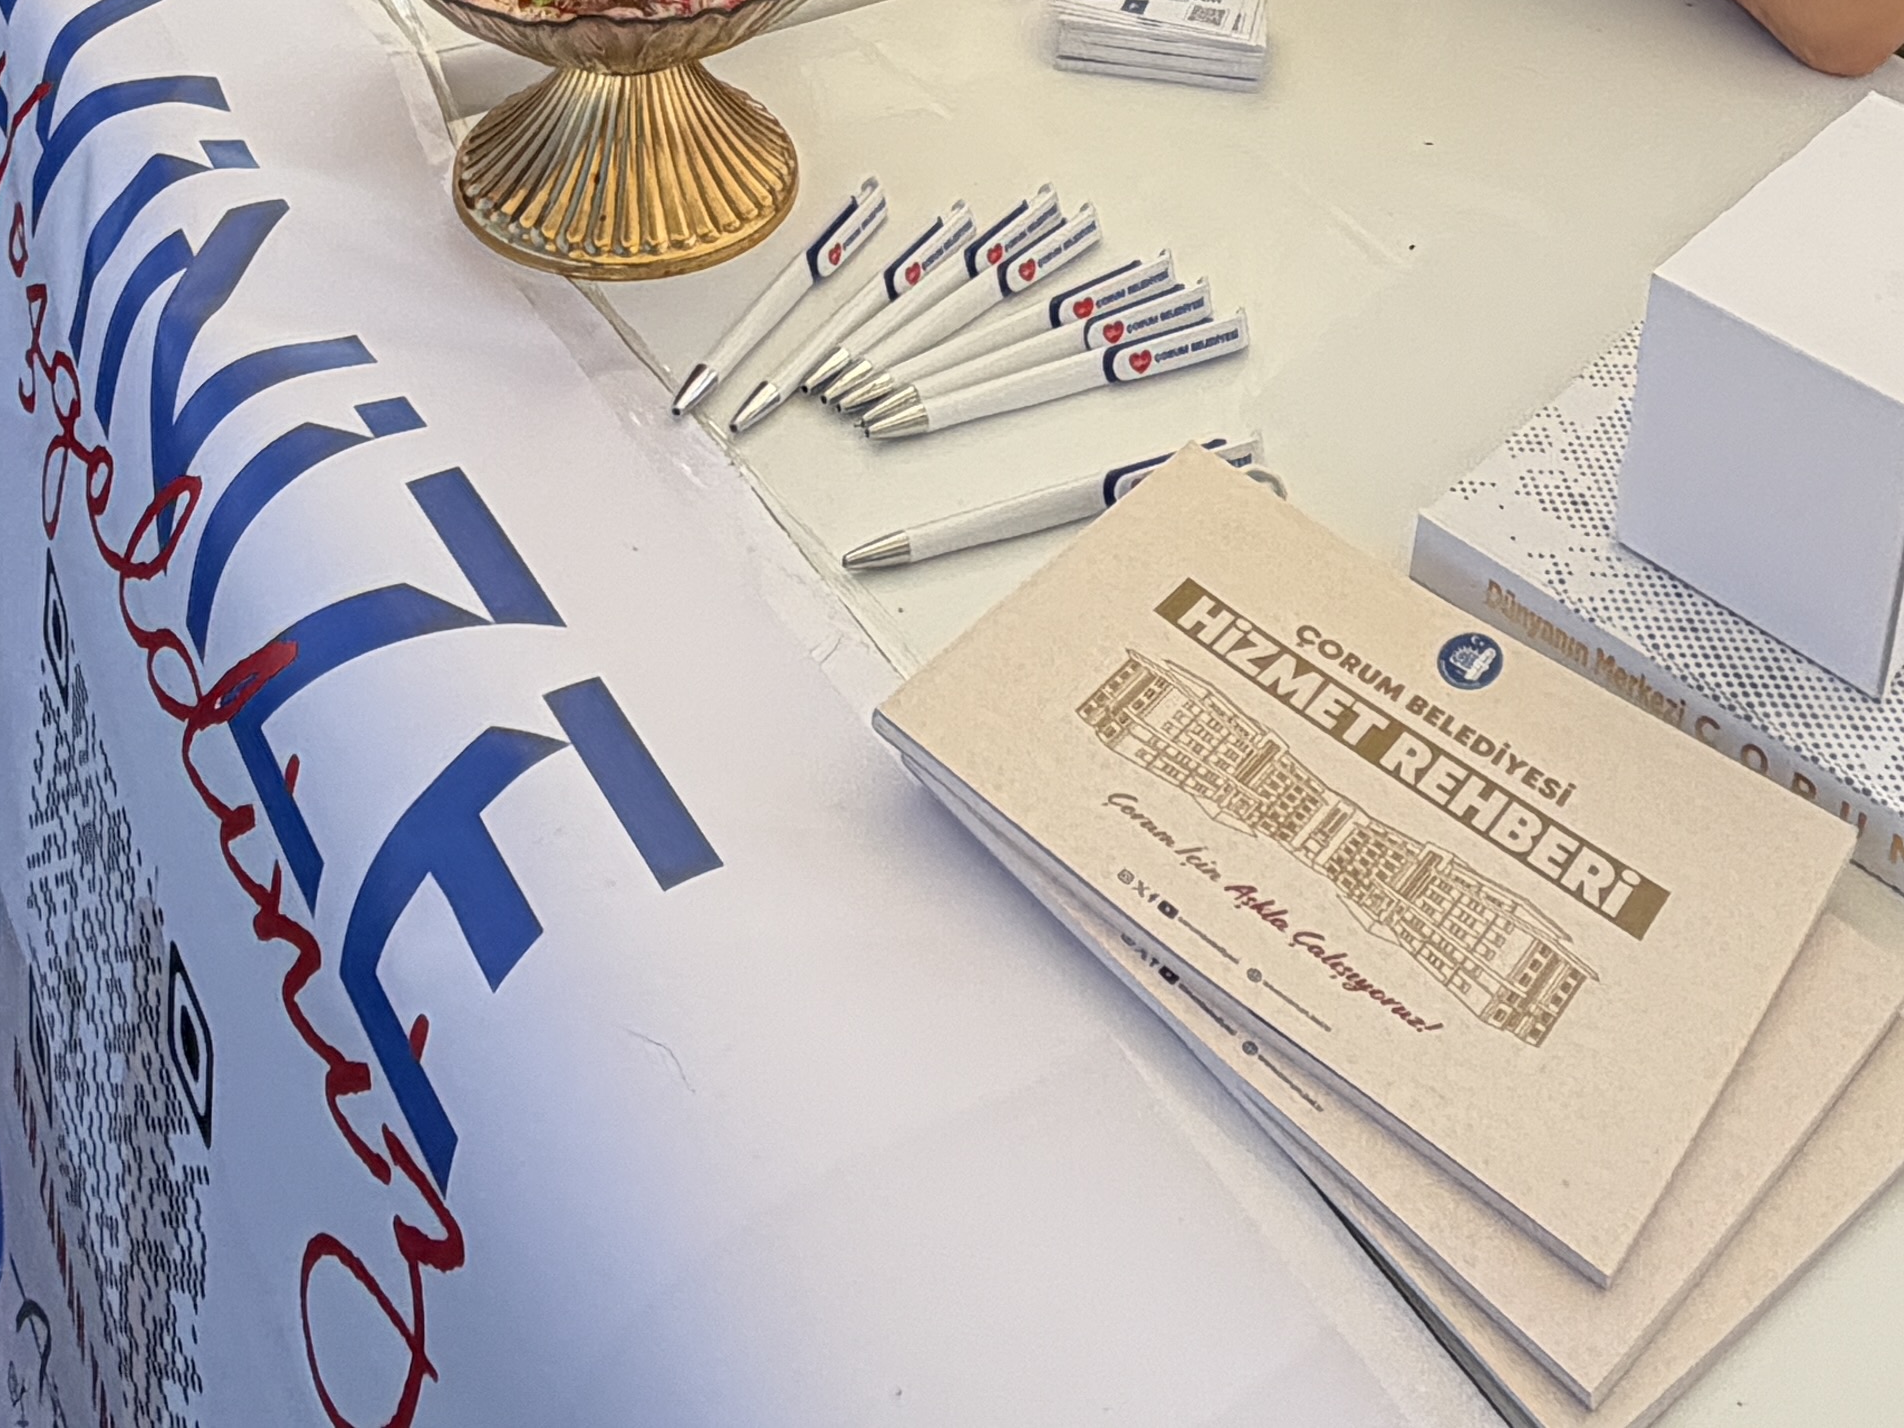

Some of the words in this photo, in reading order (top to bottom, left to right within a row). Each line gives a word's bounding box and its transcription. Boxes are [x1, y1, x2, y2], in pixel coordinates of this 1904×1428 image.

[1176, 594, 1388, 749] HİZMET
[1380, 730, 1641, 916] REHBERİ
[1295, 624, 1407, 703] ÇORUM
[1404, 692, 1577, 809] BELEDİYESİ
[1101, 792, 1175, 848] Çorum
[1223, 884, 1289, 933] Aşkla
